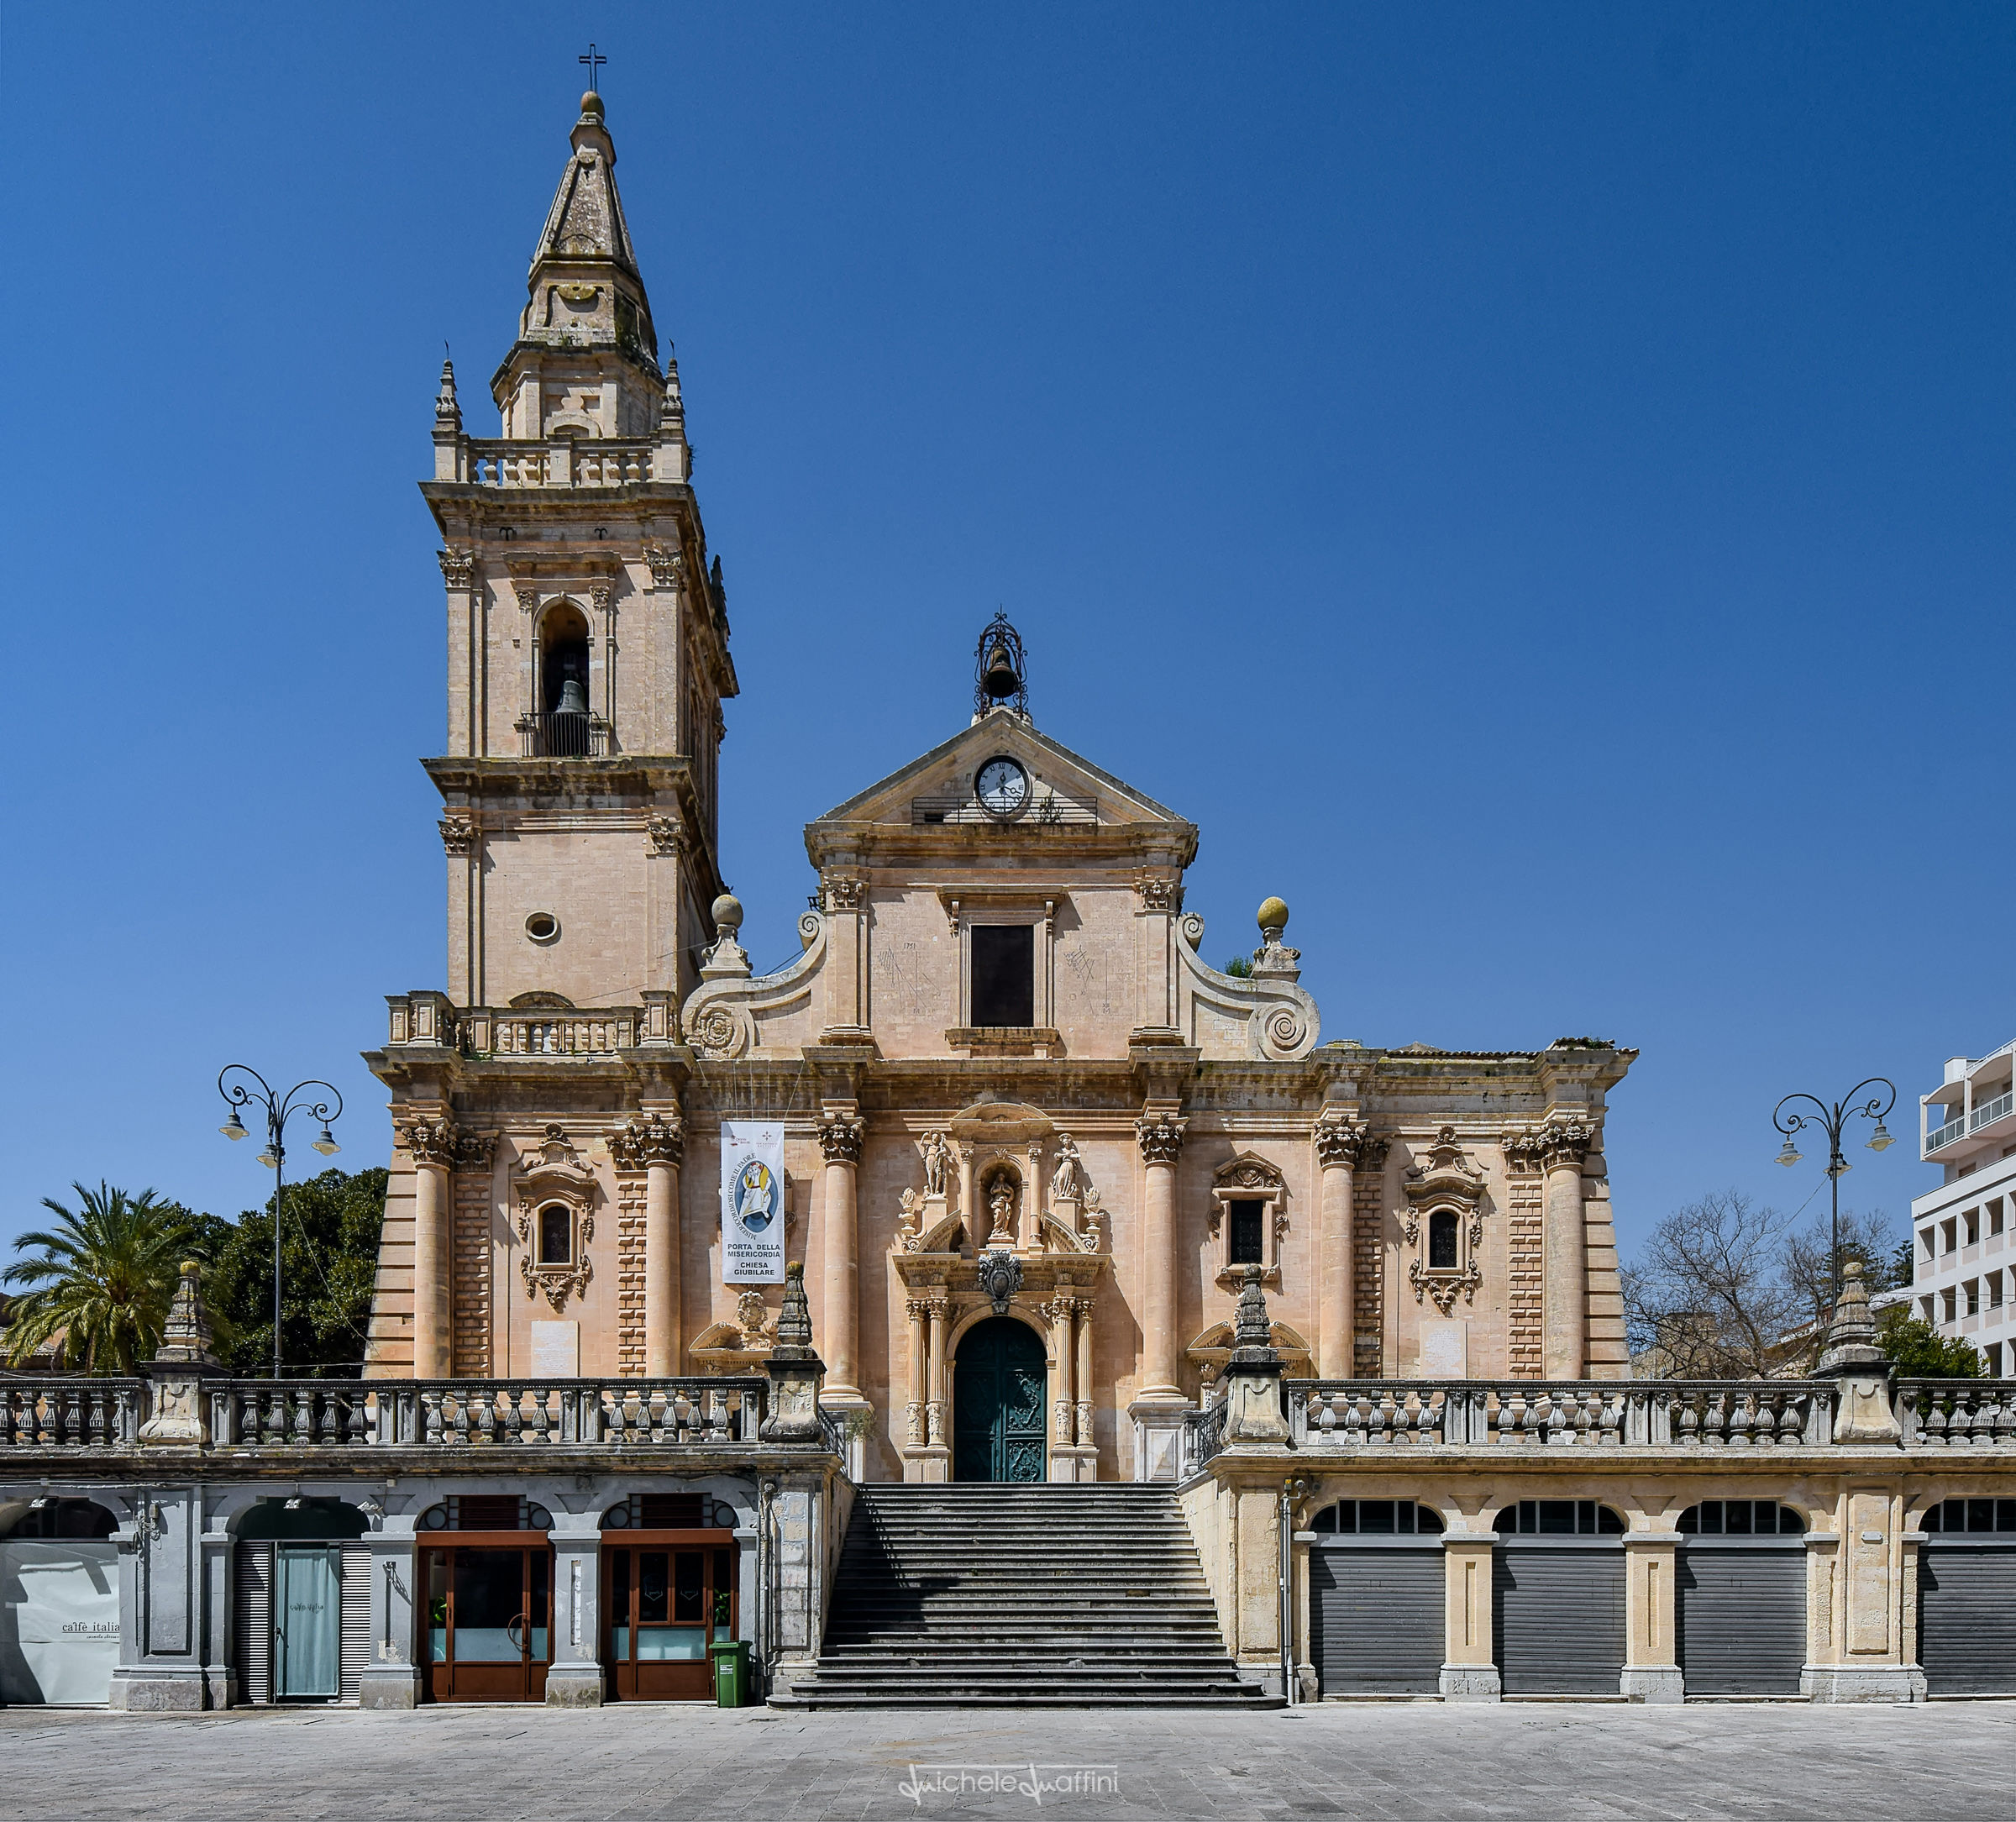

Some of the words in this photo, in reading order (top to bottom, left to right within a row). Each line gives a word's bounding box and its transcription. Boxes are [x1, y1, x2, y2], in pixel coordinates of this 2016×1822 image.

[737, 1153, 757, 1168] PADRE
[728, 1175, 737, 1194] COME
[728, 1195, 757, 1240] MISERICORDIOSI
[93, 1621, 120, 1631] italia
